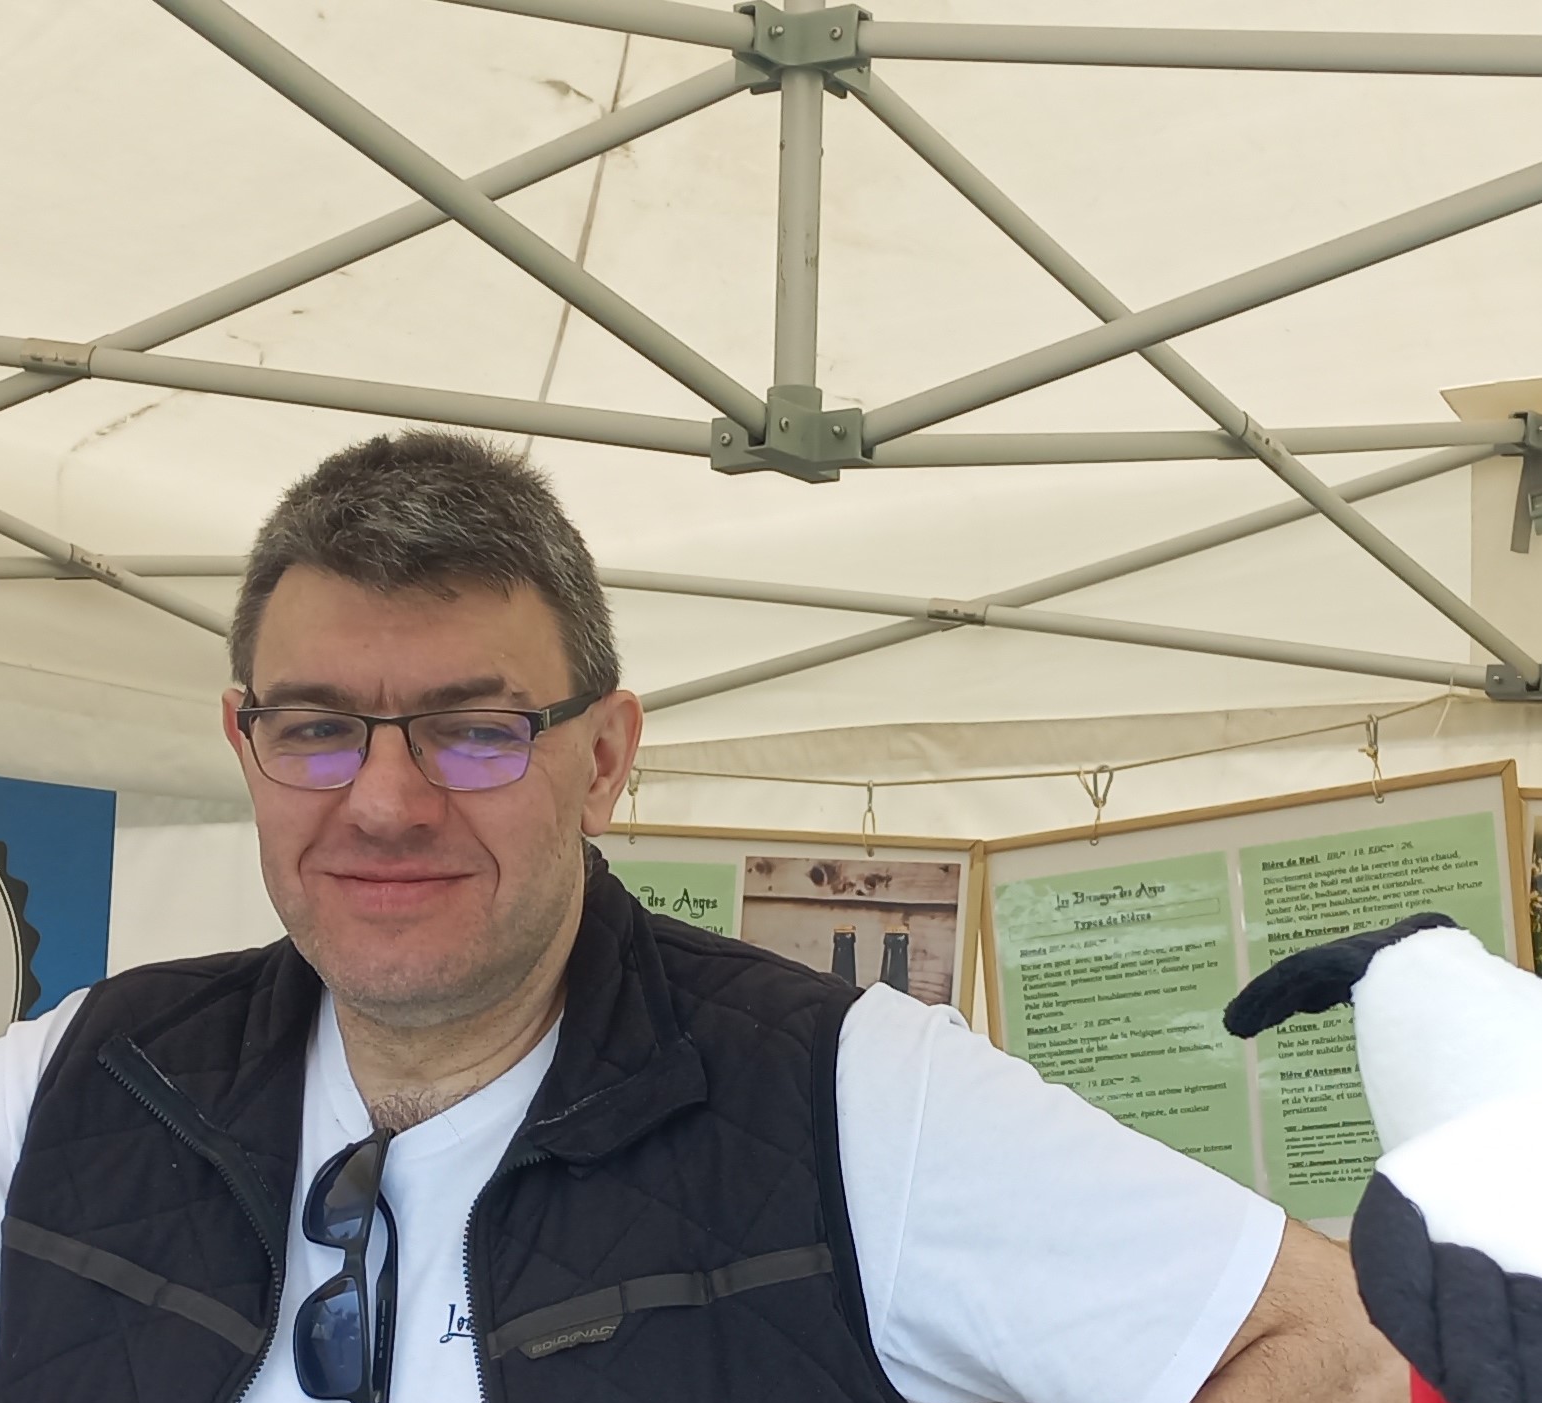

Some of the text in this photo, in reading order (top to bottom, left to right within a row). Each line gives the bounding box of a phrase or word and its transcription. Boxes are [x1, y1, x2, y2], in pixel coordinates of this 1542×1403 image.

[1262, 854, 1320, 871] Bière de Noël
[639, 886, 718, 919] des Anges
[1074, 912, 1151, 931] Types de bières
